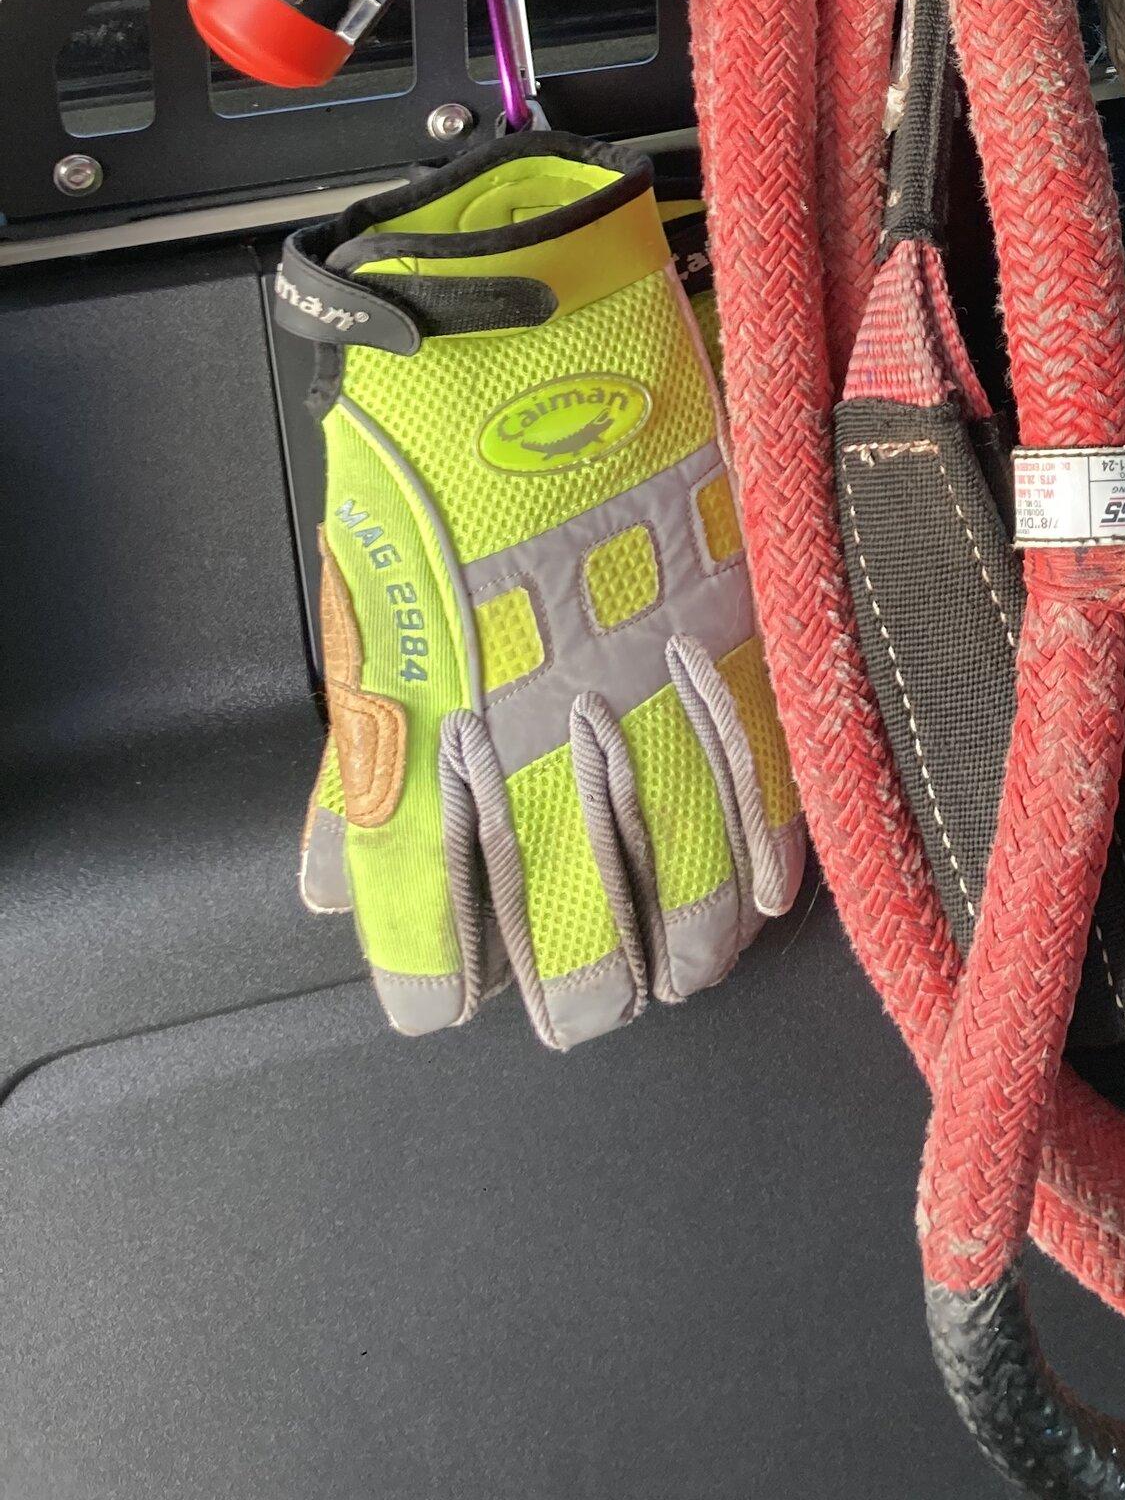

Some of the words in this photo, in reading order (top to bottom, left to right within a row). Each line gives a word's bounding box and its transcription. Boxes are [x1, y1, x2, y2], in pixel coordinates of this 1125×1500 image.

[496, 386, 630, 442] Caiman
[334, 498, 402, 570] MAG
[385, 581, 429, 683] 2984
